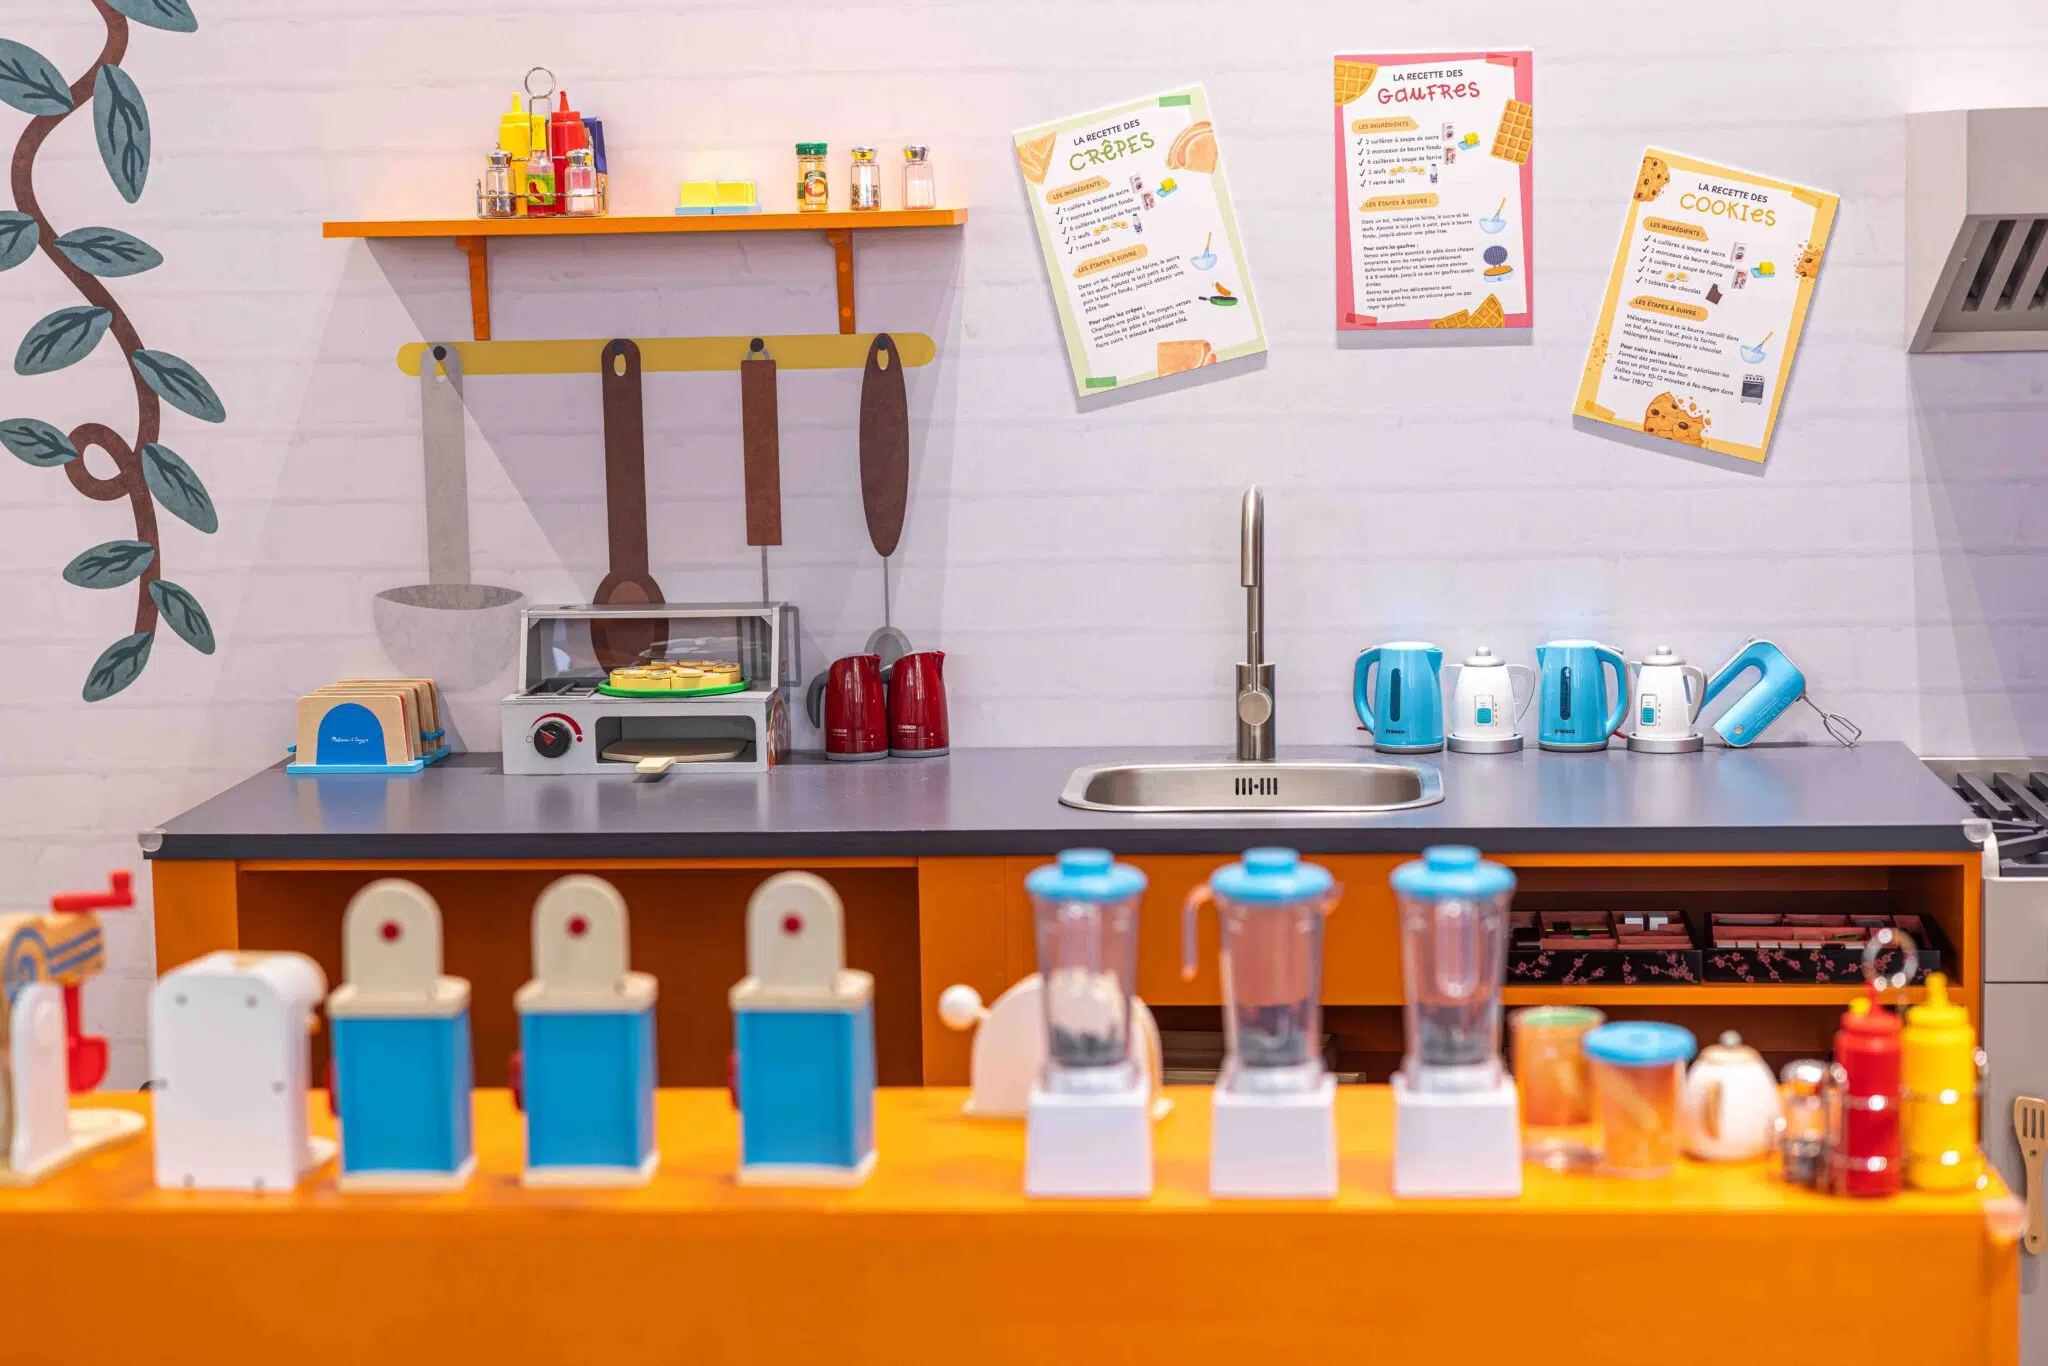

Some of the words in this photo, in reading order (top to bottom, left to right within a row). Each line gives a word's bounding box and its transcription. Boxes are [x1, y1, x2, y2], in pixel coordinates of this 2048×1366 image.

[1406, 70, 1443, 80] RECETTE
[1446, 69, 1463, 77] DES
[1086, 124, 1121, 141] RECETTE
[1123, 118, 1140, 130] DES
[1711, 185, 1749, 199] RECETTE
[1750, 192, 1767, 203] DES
[1077, 265, 1088, 274] LES
[1088, 258, 1110, 269] ÉTAPES
[1116, 250, 1137, 261] SUIVRE
[1646, 300, 1668, 310] ÉTAPES
[1675, 306, 1696, 316] SUIVRE
